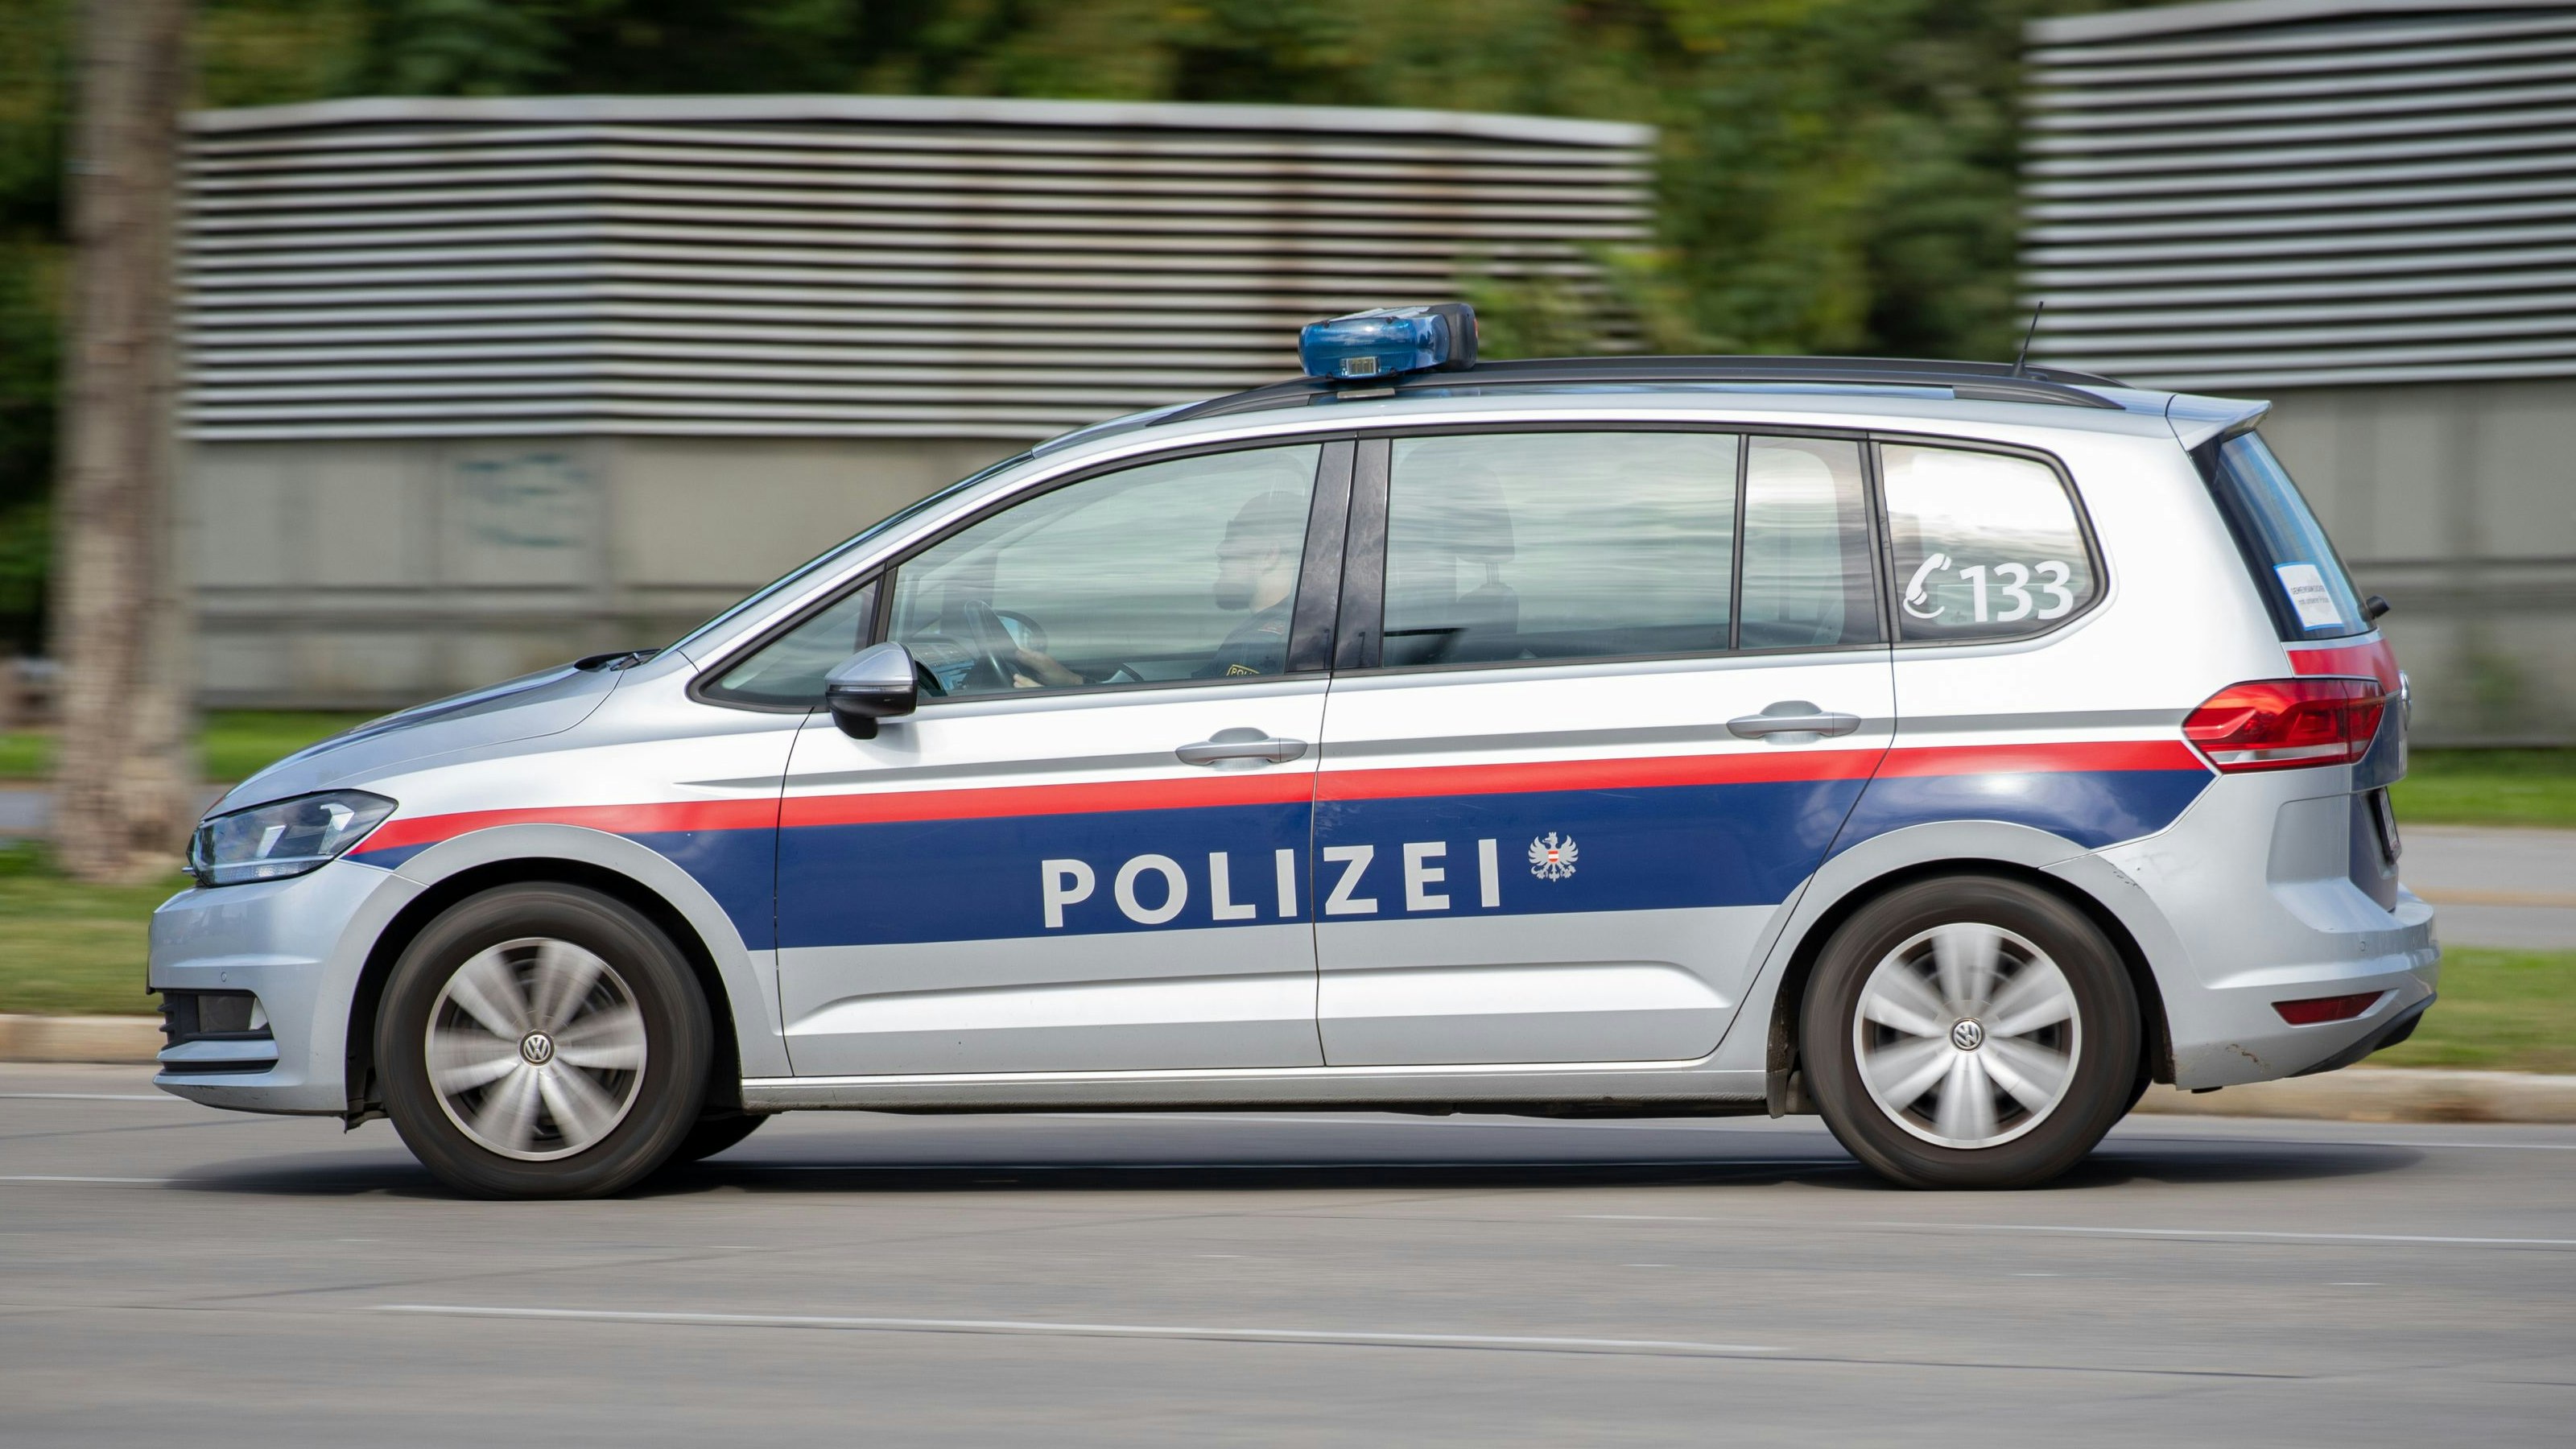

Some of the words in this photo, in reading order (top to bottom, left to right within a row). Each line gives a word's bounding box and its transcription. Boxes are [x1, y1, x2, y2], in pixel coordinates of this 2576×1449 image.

[1959, 560, 2074, 622] 133
[1042, 839, 1501, 928] POLIZEI
[523, 1034, 551, 1063] VW
[1954, 1021, 1982, 1049] VW
